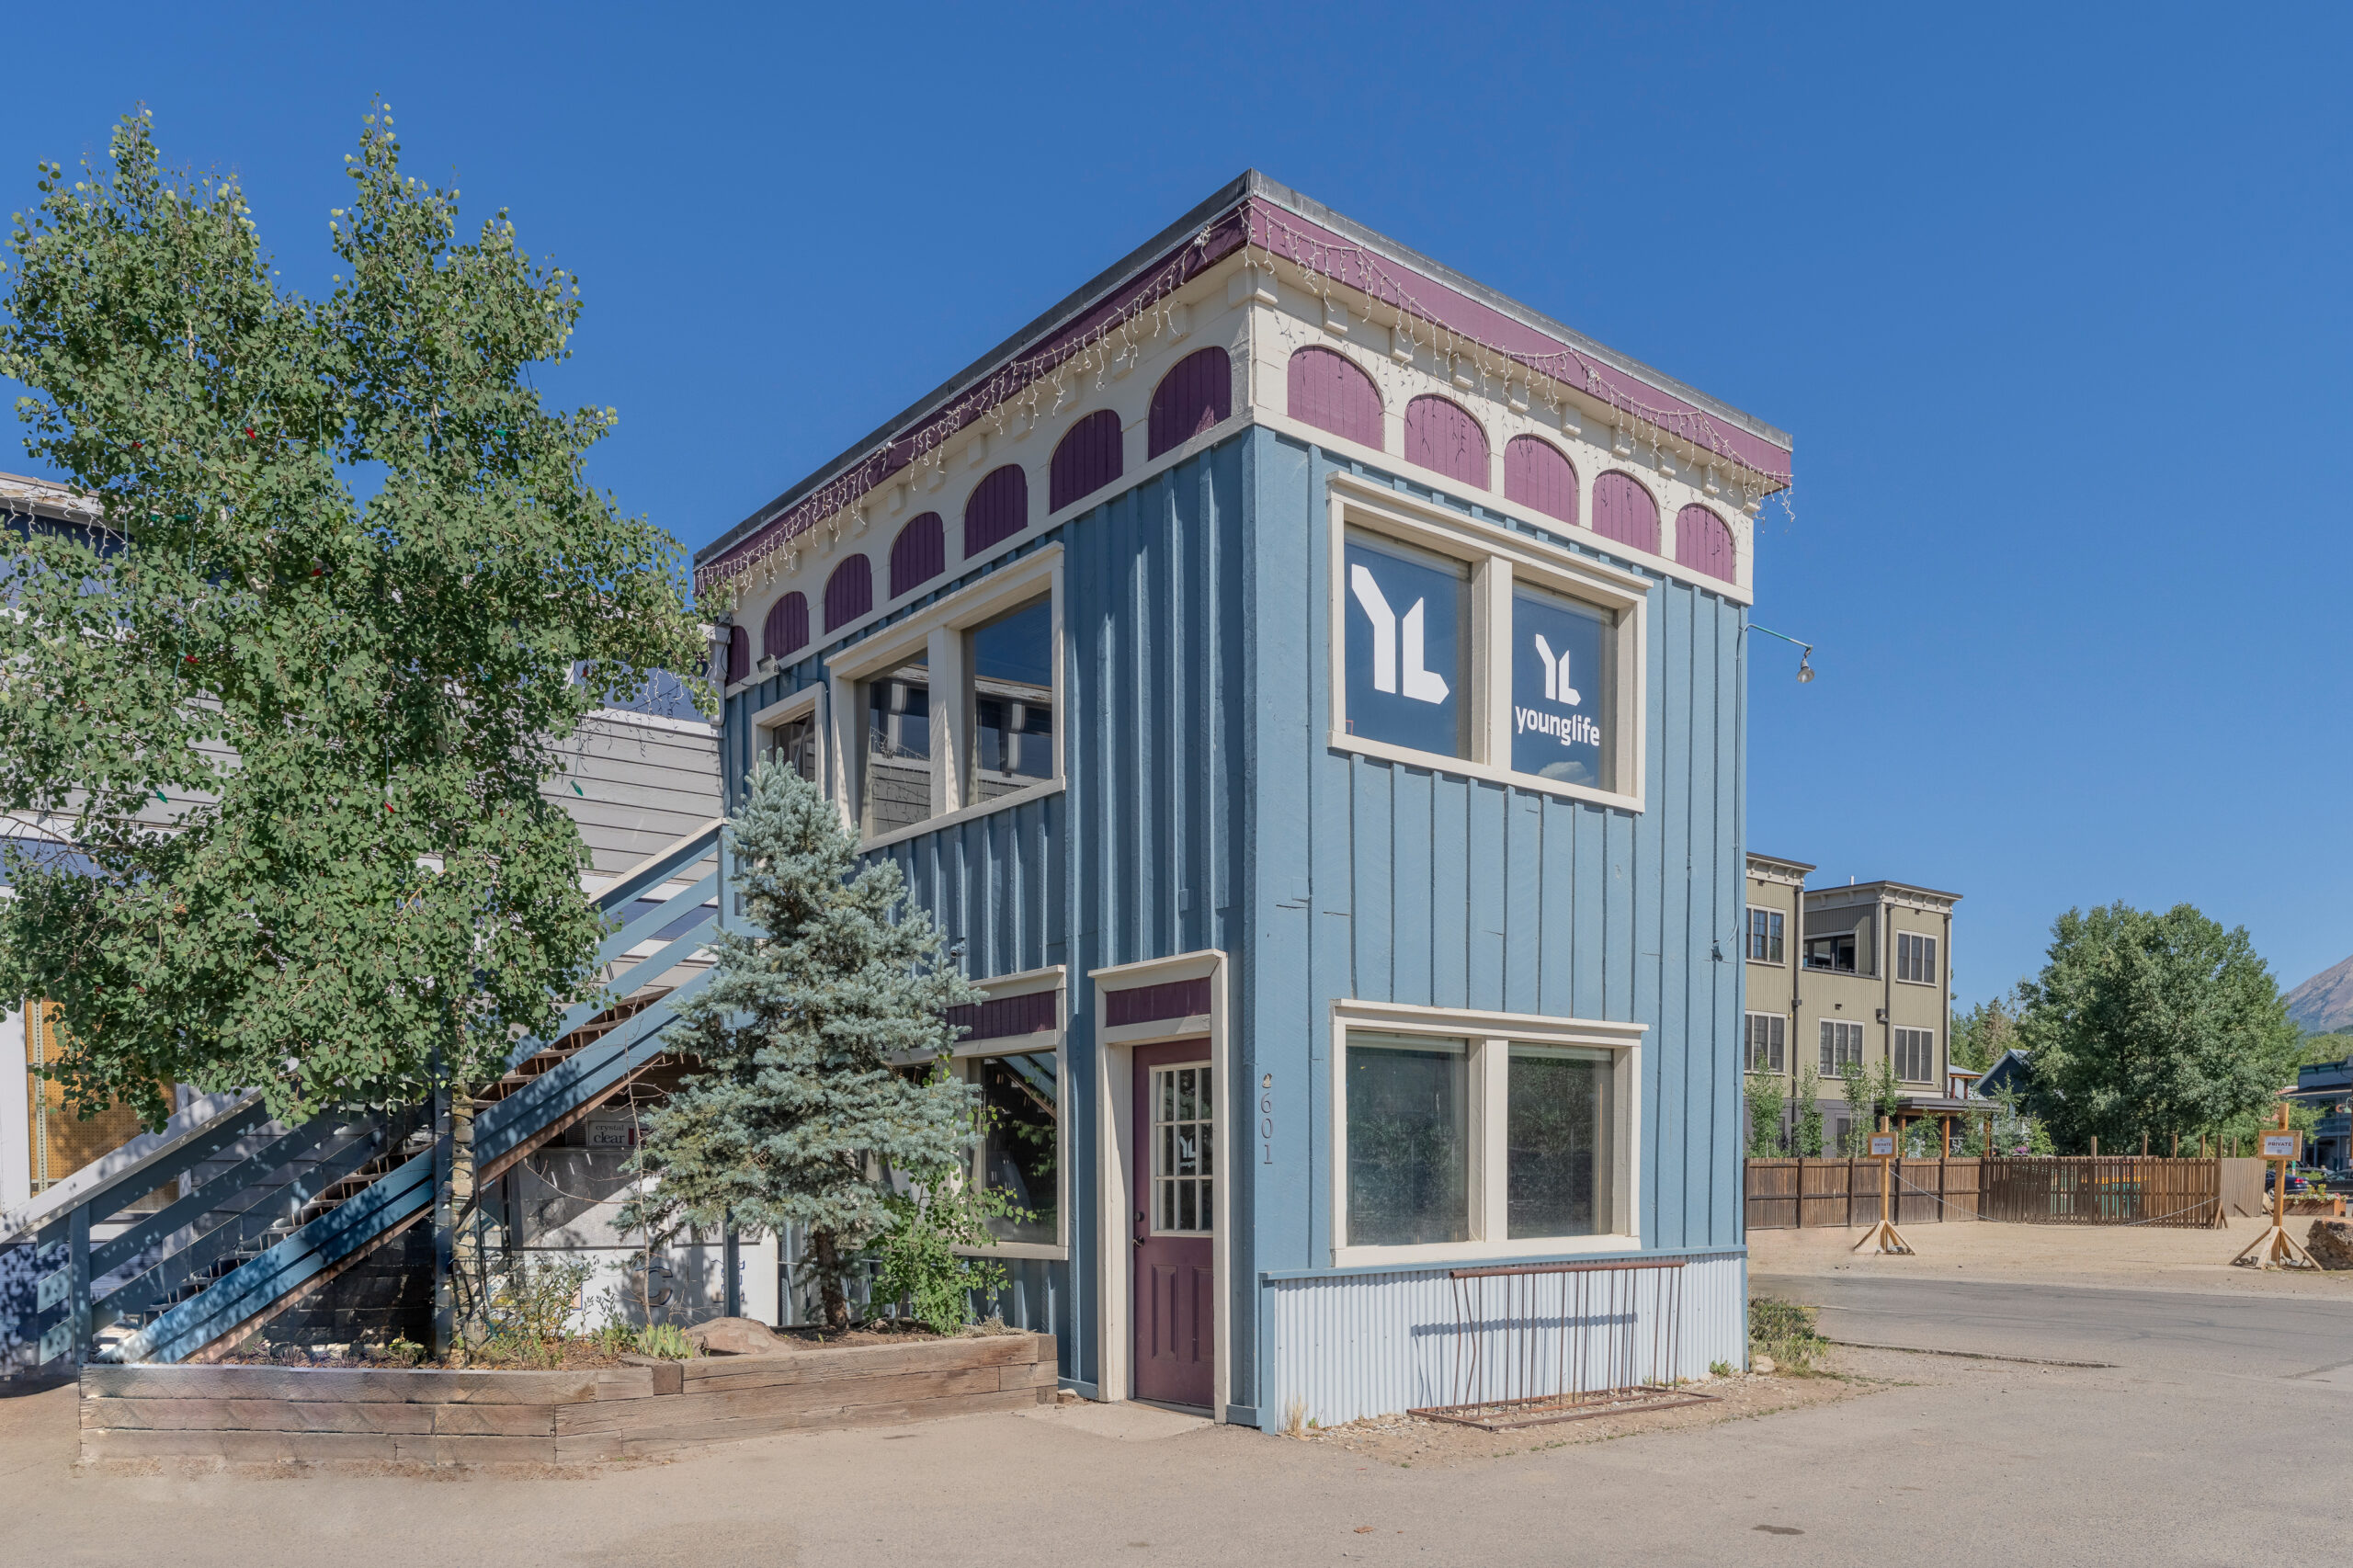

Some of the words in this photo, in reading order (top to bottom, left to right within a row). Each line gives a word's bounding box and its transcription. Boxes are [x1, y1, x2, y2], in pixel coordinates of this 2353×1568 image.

[1351, 563, 1449, 705] YL
[1535, 633, 1581, 706] YL
[1515, 705, 1600, 746] younglife
[594, 1131, 625, 1143] clear
